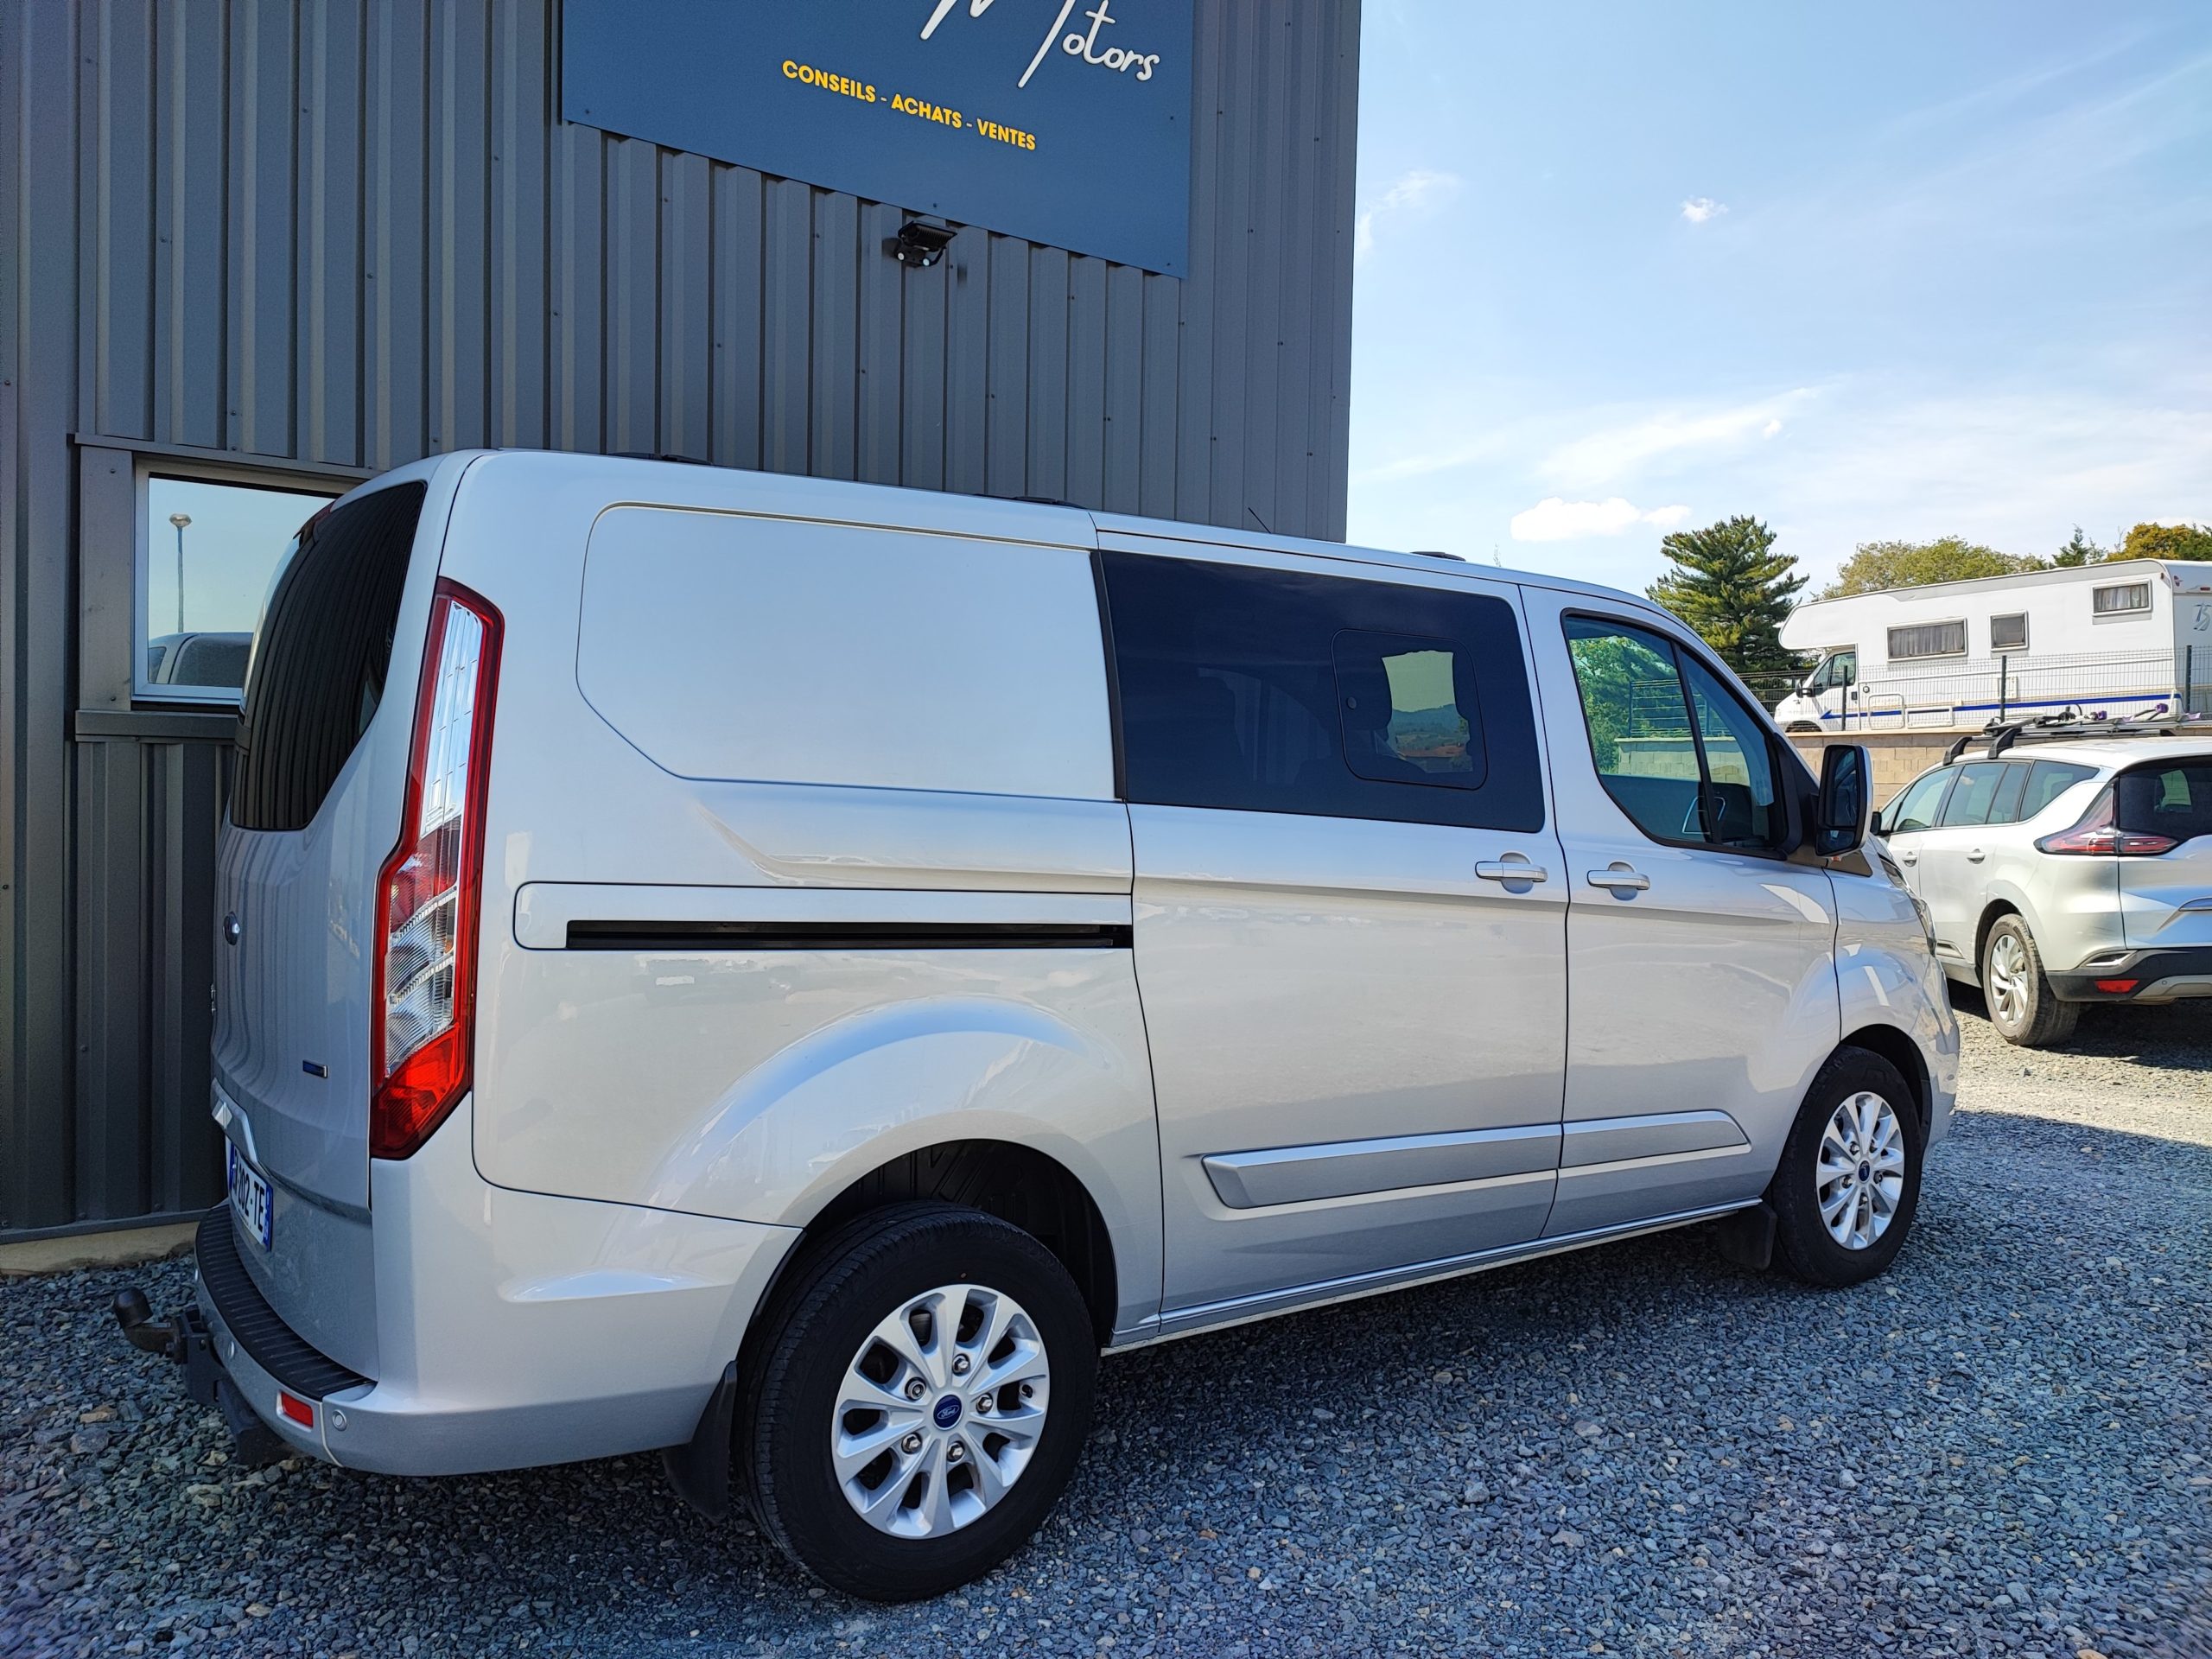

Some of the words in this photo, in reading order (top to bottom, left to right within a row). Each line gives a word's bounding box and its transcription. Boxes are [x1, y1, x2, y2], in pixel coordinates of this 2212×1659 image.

[782, 60, 876, 103] CONSEILS
[891, 93, 962, 129] ACHATS
[976, 118, 1036, 150] VENTES
